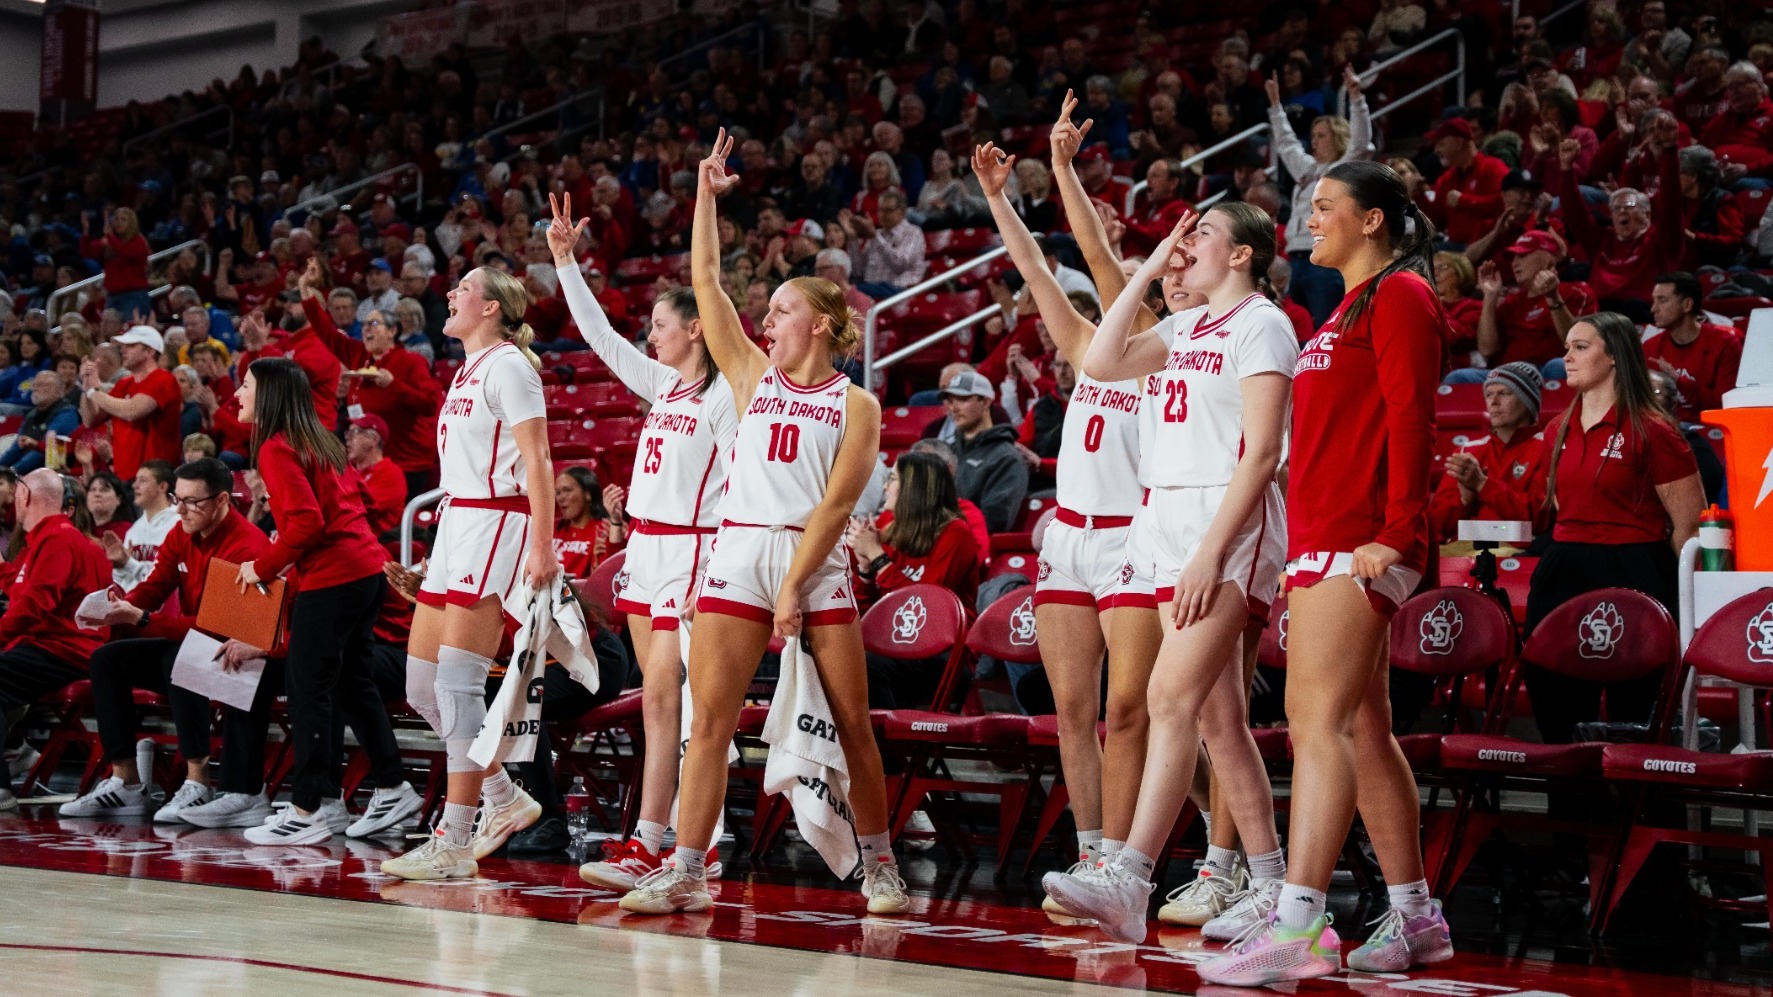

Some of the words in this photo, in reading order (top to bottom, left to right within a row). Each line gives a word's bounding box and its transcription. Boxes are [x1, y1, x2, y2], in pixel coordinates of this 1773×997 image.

[788, 401, 841, 428] DAKOTA
[1164, 379, 1187, 423] 23
[767, 422, 800, 464] 10
[1084, 414, 1105, 453] 0
[643, 437, 664, 474] 25
[503, 719, 540, 737] ADE
[797, 713, 837, 743] GAT
[911, 721, 949, 733] COYOTES
[1478, 749, 1526, 763] COYOTES
[1643, 758, 1696, 774] COYOTES
